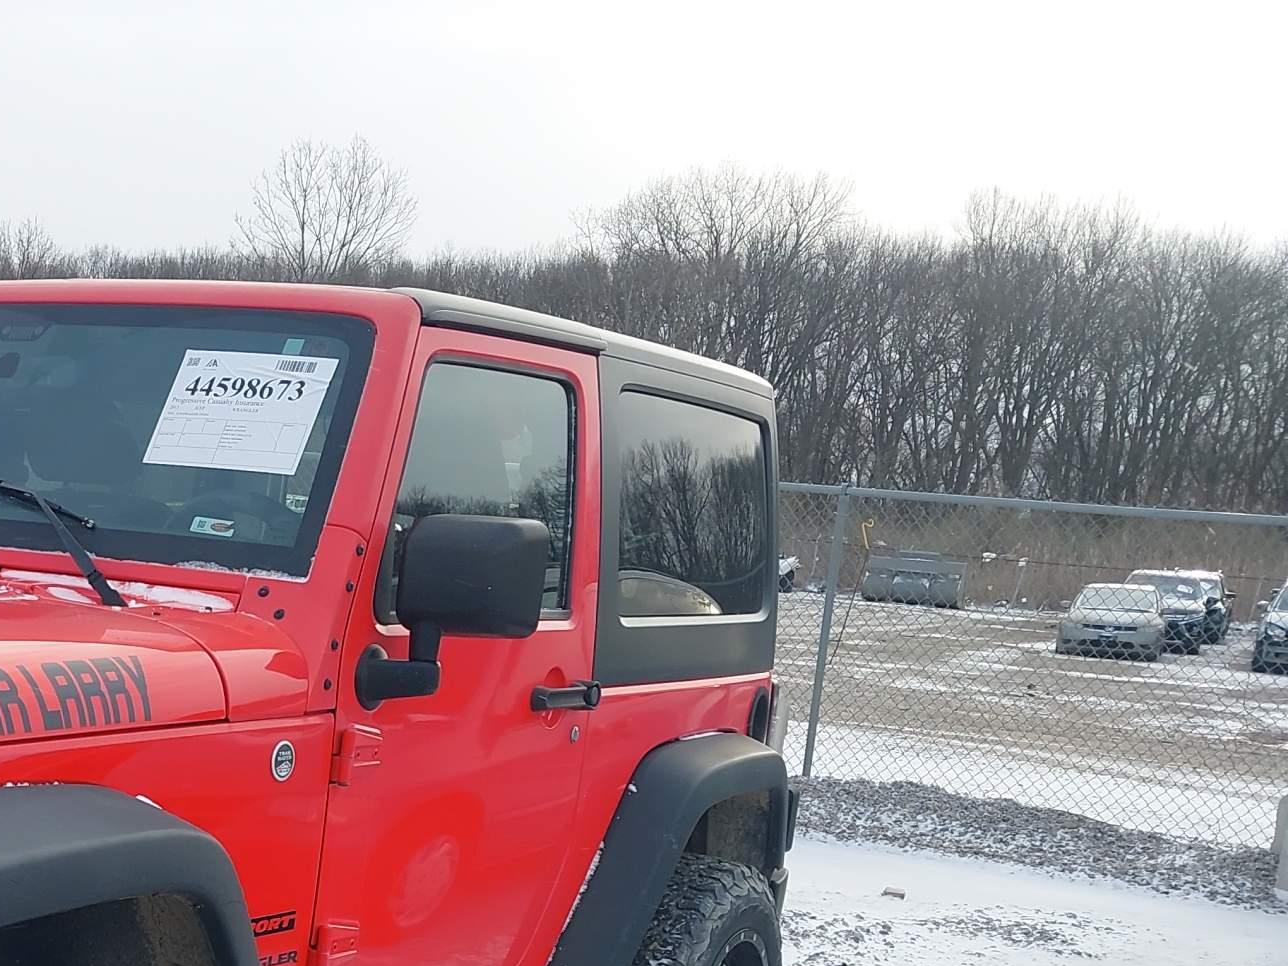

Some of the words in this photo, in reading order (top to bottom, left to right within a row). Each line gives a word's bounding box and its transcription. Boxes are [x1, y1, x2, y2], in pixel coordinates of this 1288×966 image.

[185, 375, 306, 401] 44598673
[16, 655, 152, 731] LARRY
[252, 915, 297, 934] ORT
